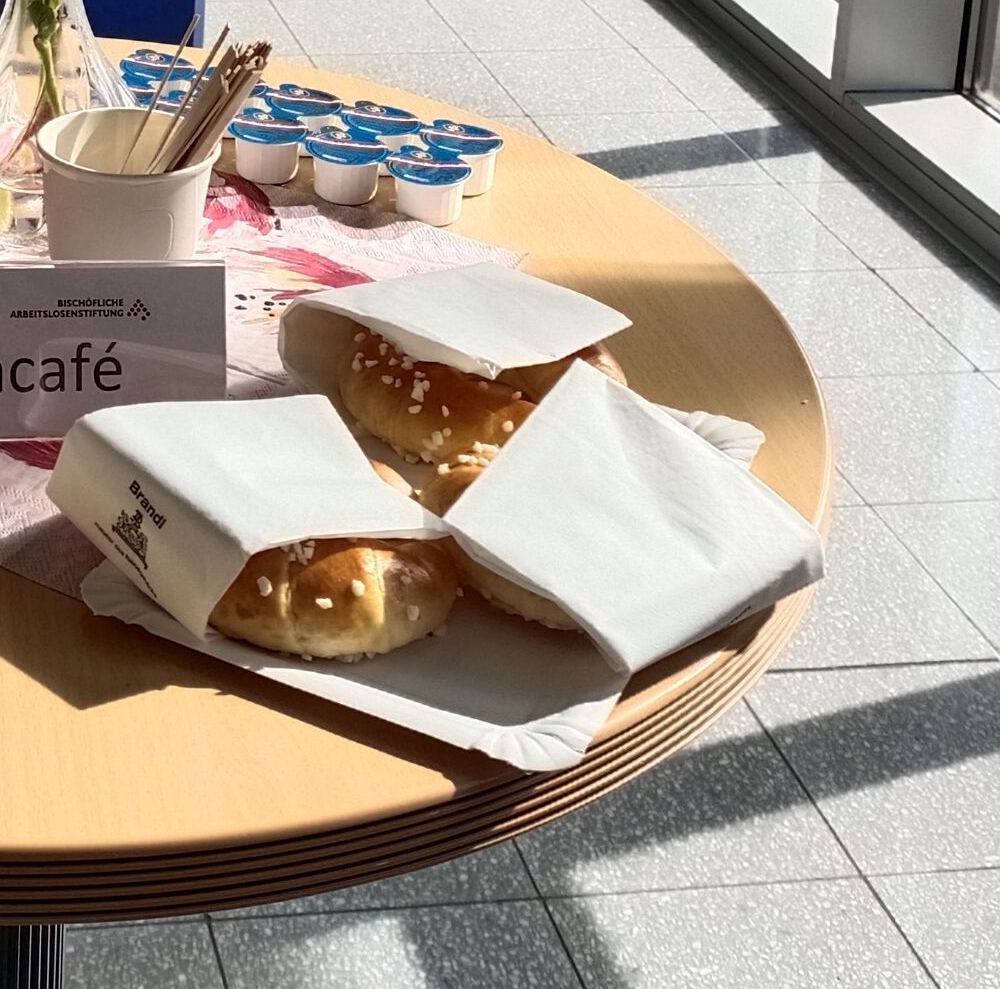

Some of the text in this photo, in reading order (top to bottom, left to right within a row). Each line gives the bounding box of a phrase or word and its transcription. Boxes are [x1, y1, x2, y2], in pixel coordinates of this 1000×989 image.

[57, 297, 124, 308] BISCHÖFLICHE
[10, 309, 124, 319] ARBEITSLOSENSTIFTUNG
[129, 480, 167, 529] Brandl
